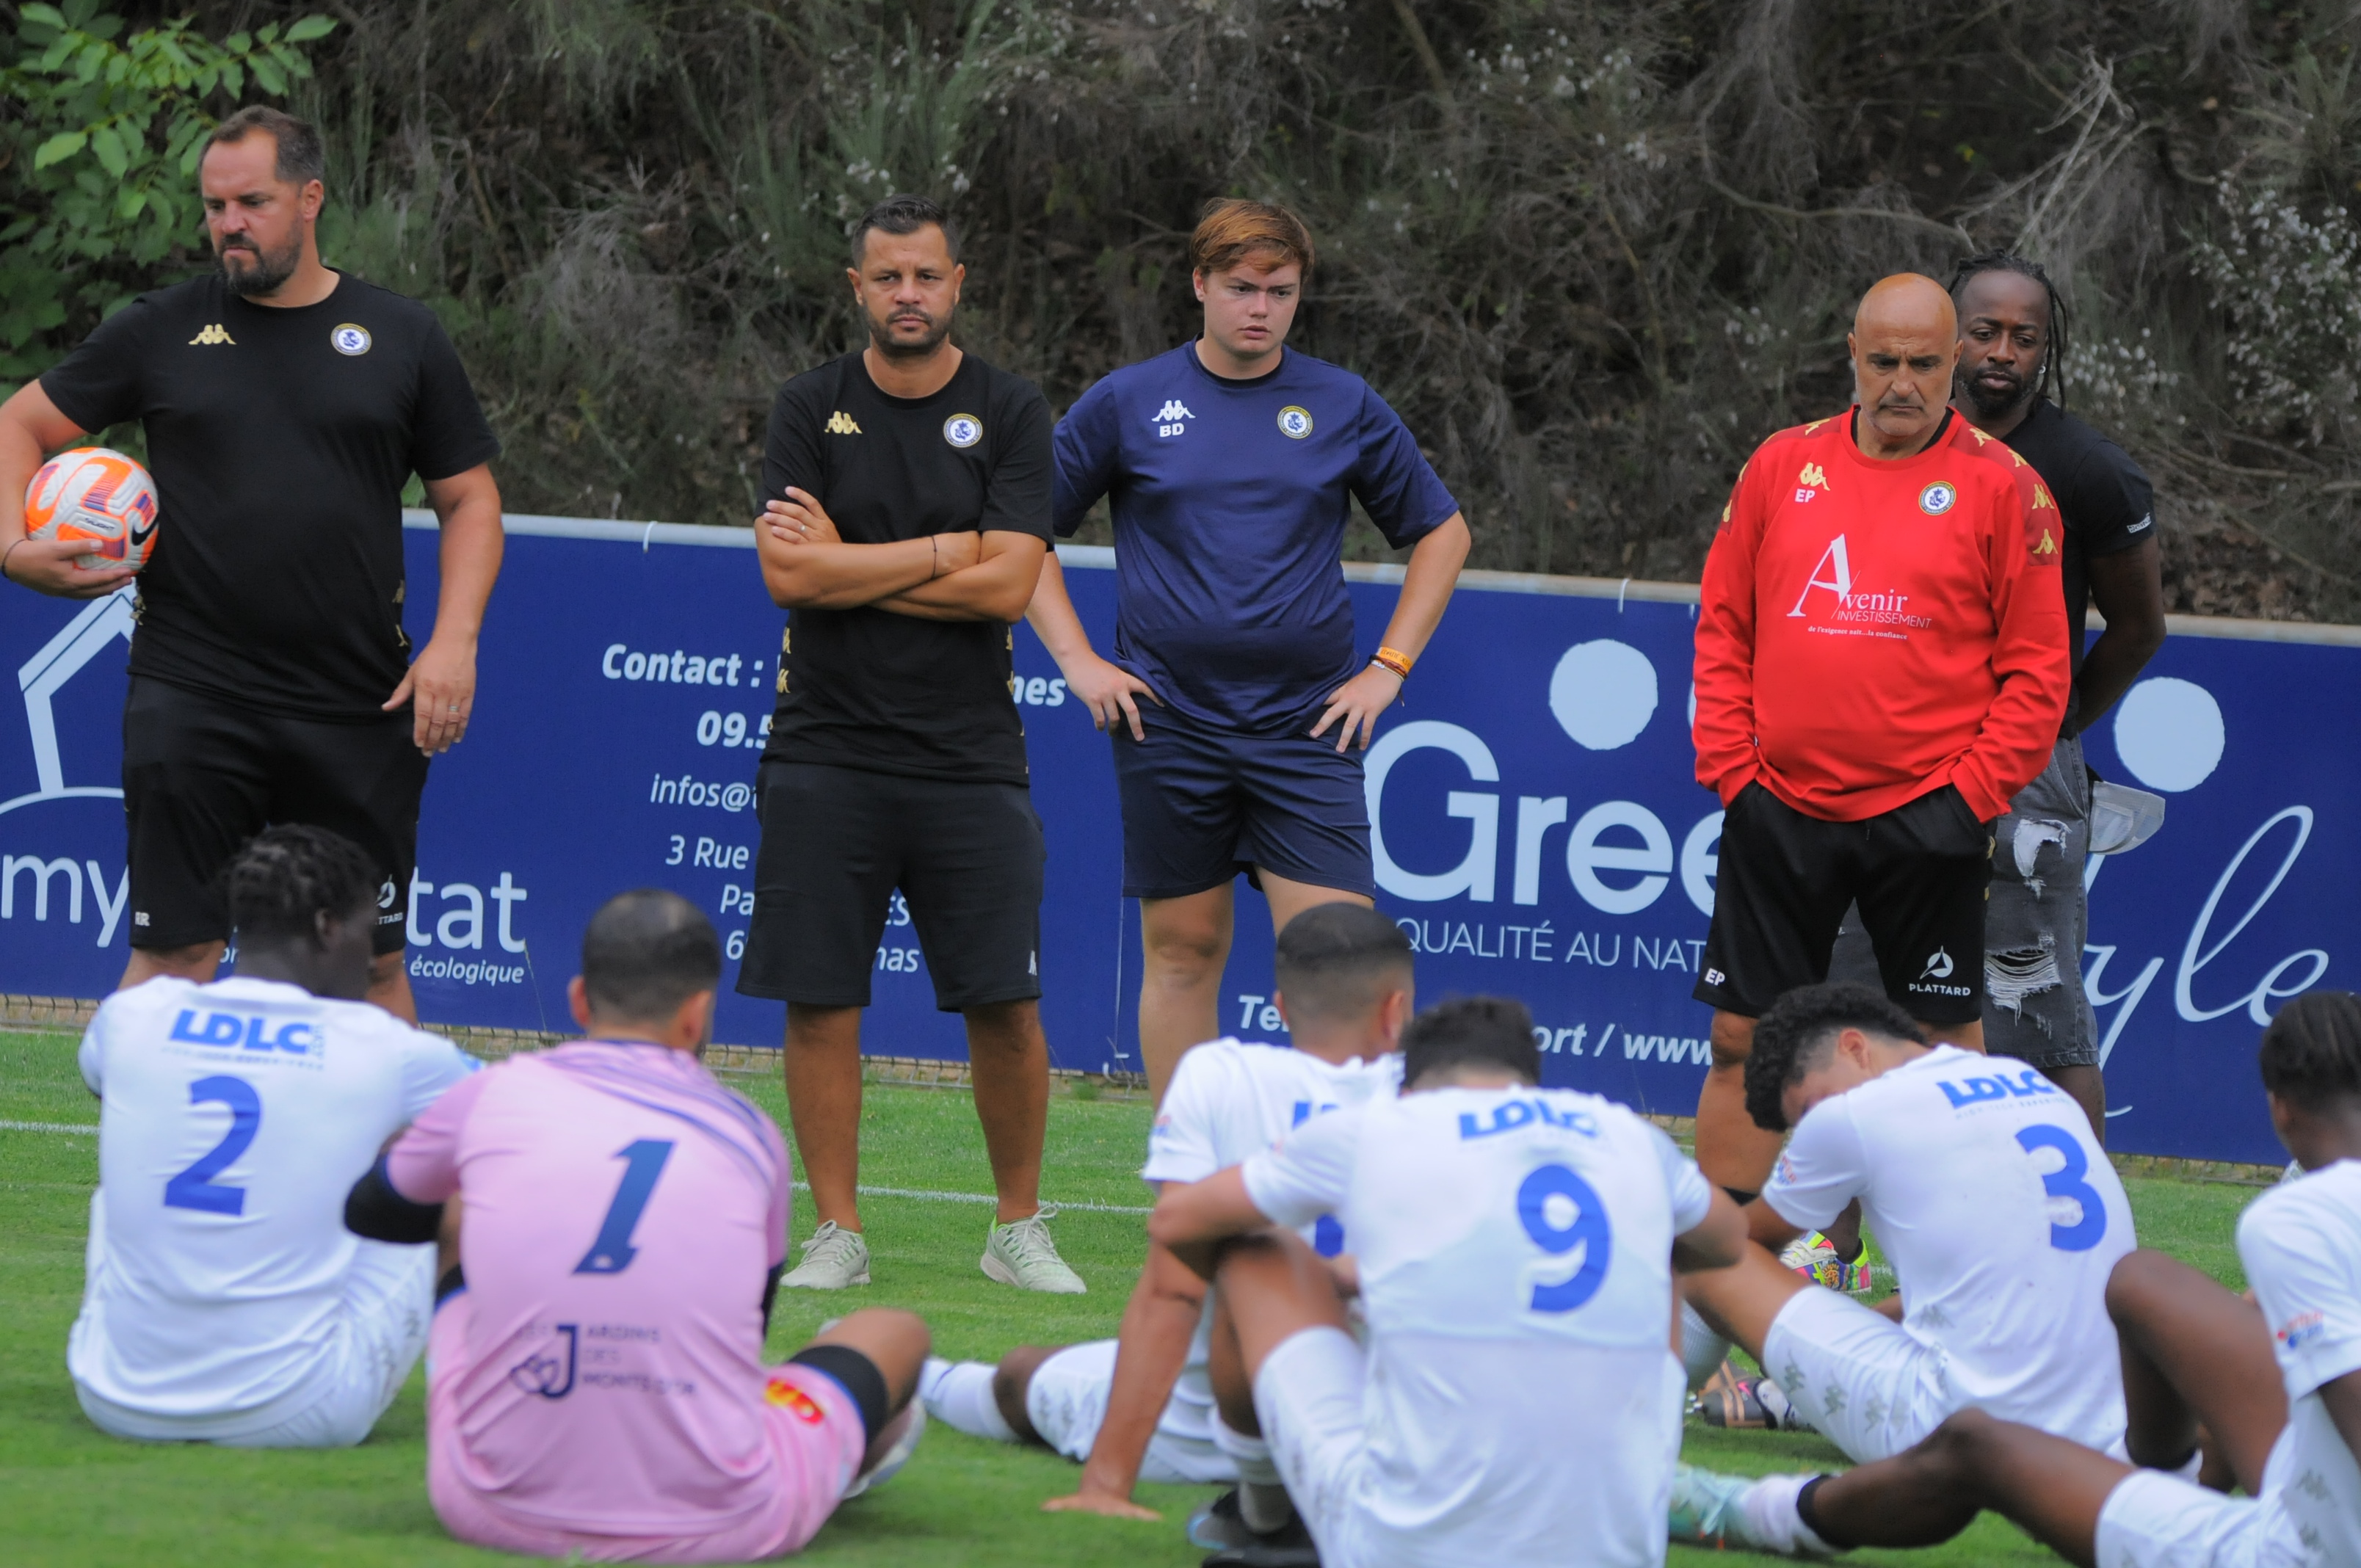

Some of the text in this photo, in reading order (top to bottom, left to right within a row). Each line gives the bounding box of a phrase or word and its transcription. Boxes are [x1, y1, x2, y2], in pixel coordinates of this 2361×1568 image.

[1160, 423, 1184, 438] BD
[1795, 488, 1816, 503] EP
[1786, 533, 1908, 617] Avenir
[1837, 610, 1932, 629] INVESTISSEMENT
[1876, 631, 1908, 640] confiance
[602, 643, 742, 687] Contact
[650, 773, 757, 812] infos@
[665, 835, 750, 870] 3 Rue
[885, 895, 910, 926] S
[1396, 918, 1708, 973] QUALITÉ AU NAT
[410, 954, 525, 987] écologique
[1705, 968, 1725, 986] EP
[1909, 983, 1971, 996] PLATTARD
[170, 1009, 311, 1056] LDLC
[1936, 1070, 2056, 1110] LDLC
[1459, 1097, 1599, 1141] LDLC
[163, 1074, 262, 1216] 2
[570, 1138, 676, 1275] 1
[2014, 1124, 2108, 1252] 3
[1517, 1164, 1613, 1314] 9
